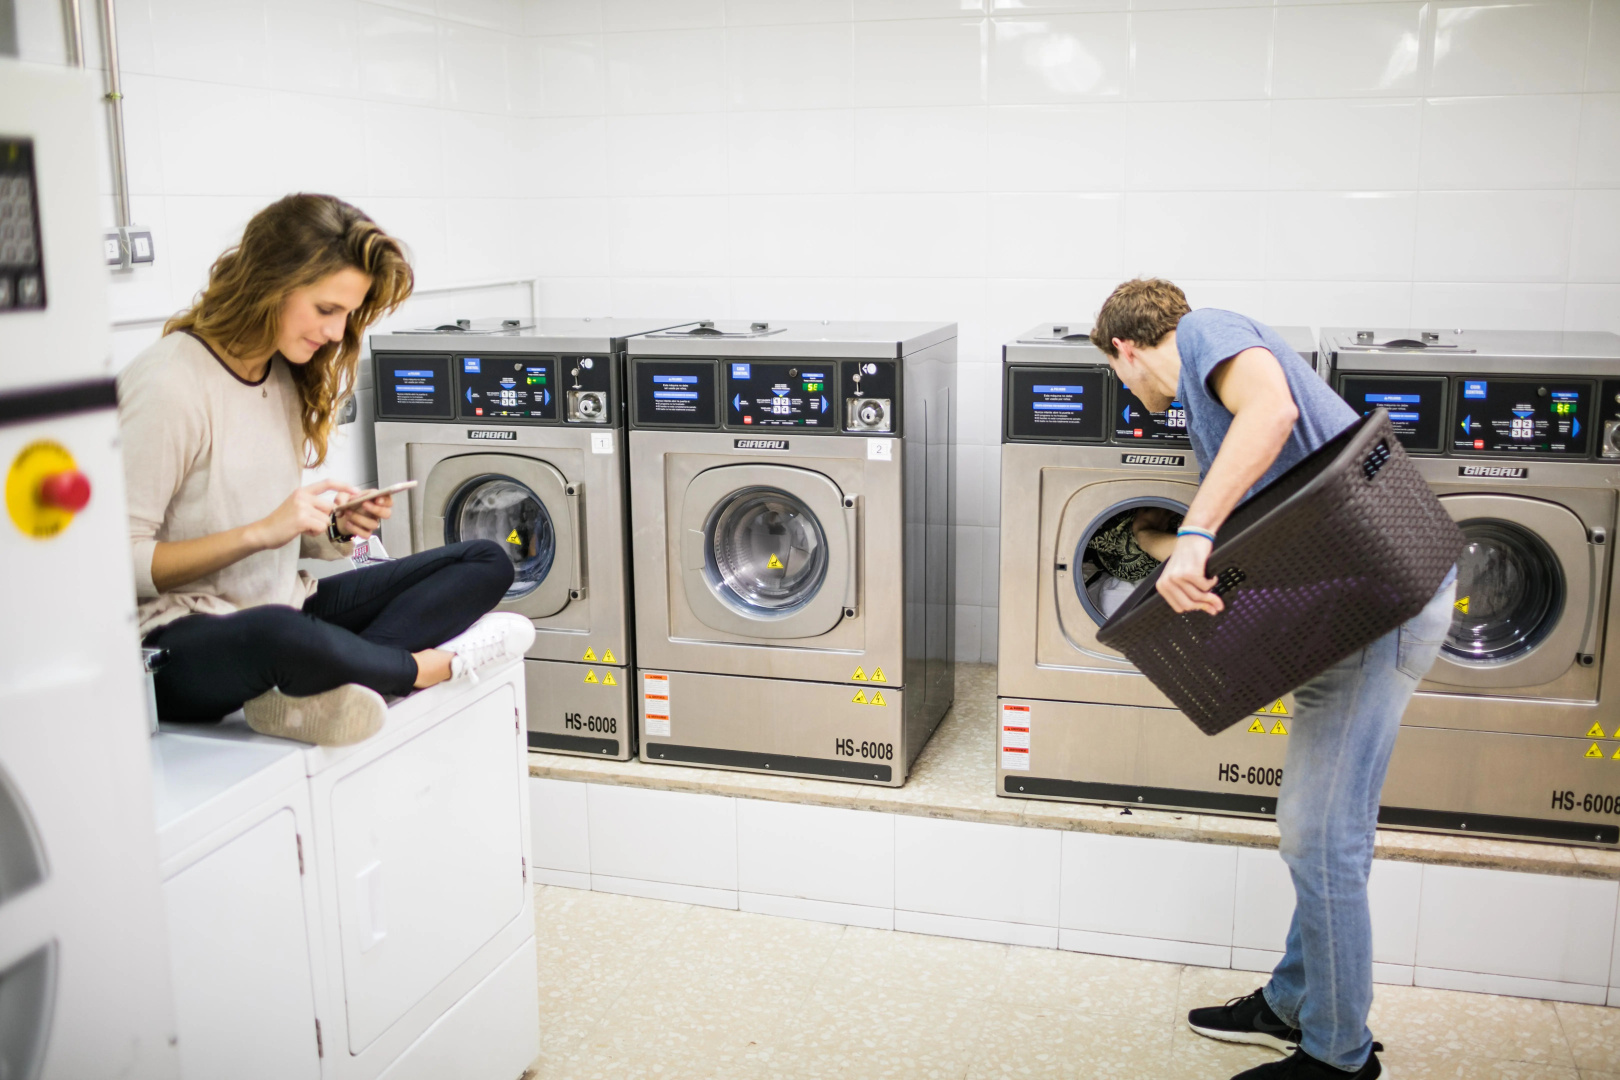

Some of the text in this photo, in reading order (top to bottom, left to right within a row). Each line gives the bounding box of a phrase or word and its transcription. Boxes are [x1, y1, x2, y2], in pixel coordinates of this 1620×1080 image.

[471, 431, 512, 439] GIRBAU
[738, 440, 785, 449] GIRBAU
[876, 445, 882, 454] 2
[1126, 454, 1180, 465] GIRBAU
[1464, 466, 1523, 477] GIRBAU
[565, 712, 617, 734] HS-6008
[836, 738, 893, 760] HS-6008
[1219, 763, 1283, 786] HS-6008
[1552, 790, 1620, 815] HS-6008
